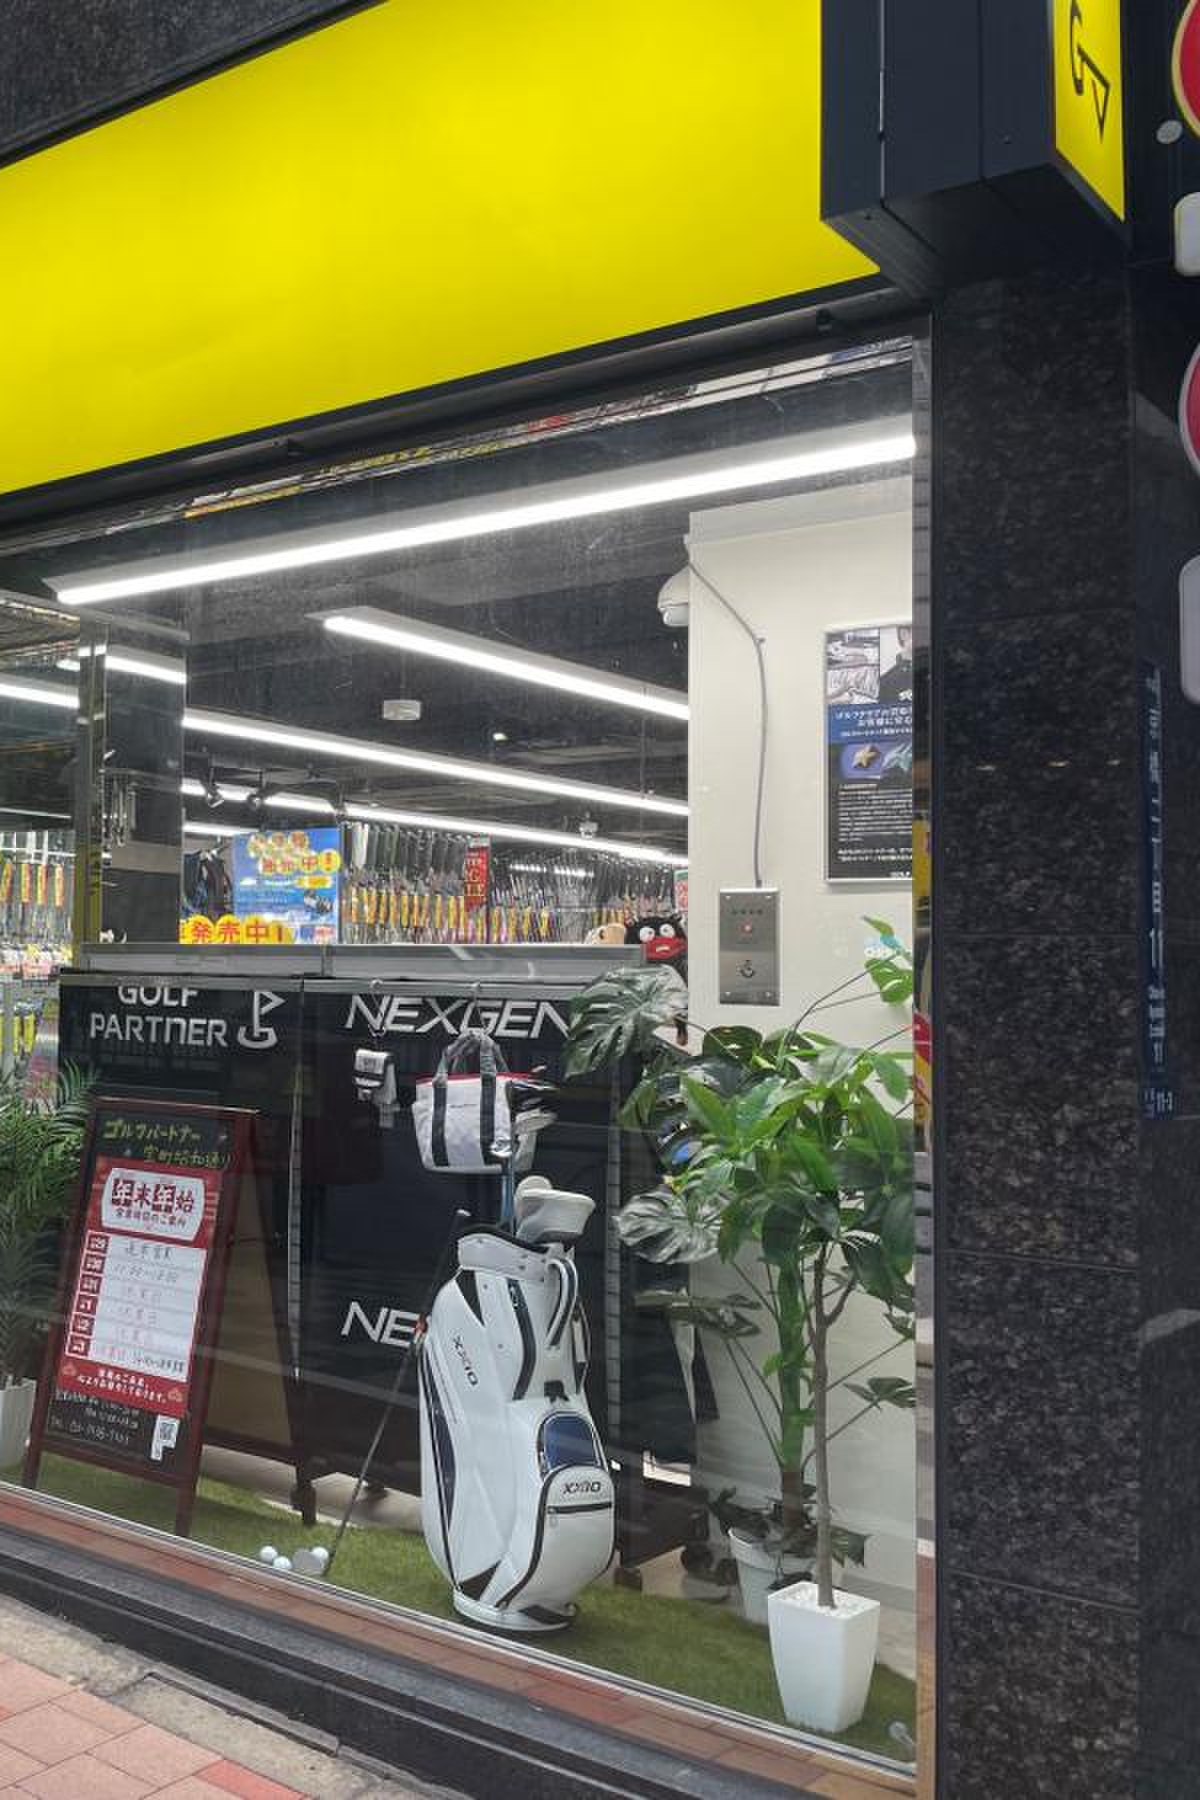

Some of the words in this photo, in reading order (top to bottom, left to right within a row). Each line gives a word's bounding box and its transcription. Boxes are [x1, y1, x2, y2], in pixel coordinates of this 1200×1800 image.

[117, 985, 198, 1007] GOLF
[90, 1012, 228, 1047] PARTNER
[344, 994, 575, 1039] NEXGEN
[111, 1178, 195, 1213] 年末年始
